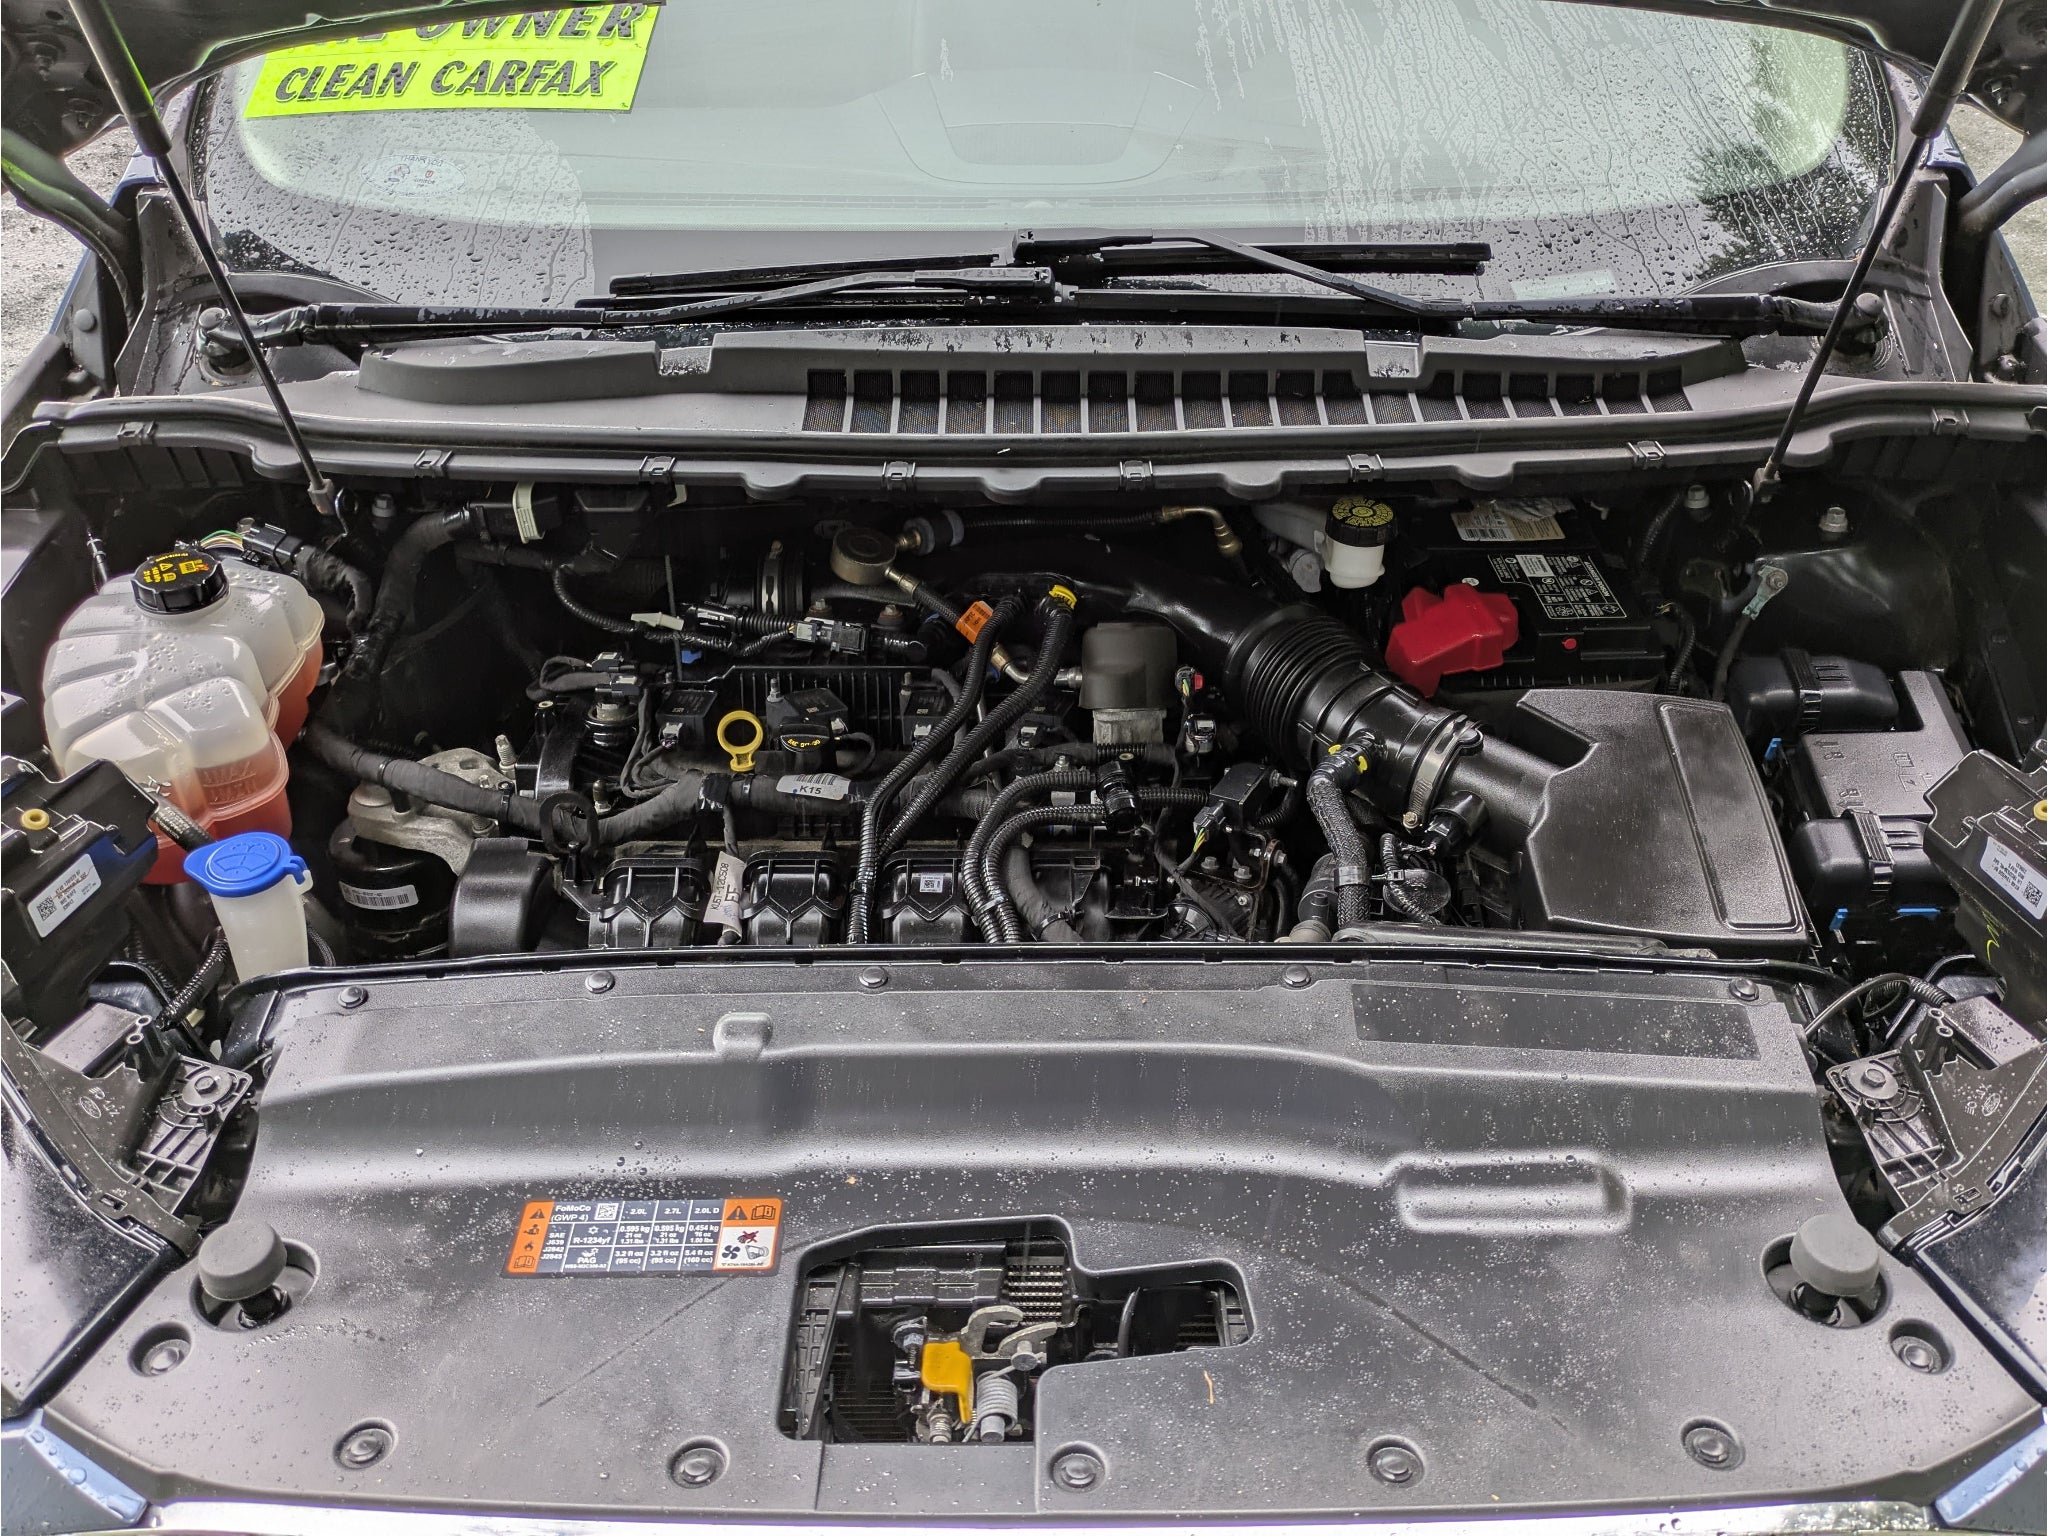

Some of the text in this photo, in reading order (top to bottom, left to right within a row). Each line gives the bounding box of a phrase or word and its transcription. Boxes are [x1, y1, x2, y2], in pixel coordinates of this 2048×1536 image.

[275, 60, 618, 103] CLEAN CARFAX
[799, 785, 822, 795] K15
[555, 1204, 592, 1212] FoMoCo
[663, 1207, 682, 1215] 2.7L
[551, 1214, 578, 1222] (GWP
[709, 1224, 719, 1233] kg
[573, 1236, 611, 1245] R-1234yf
[577, 1256, 597, 1264] PAG
